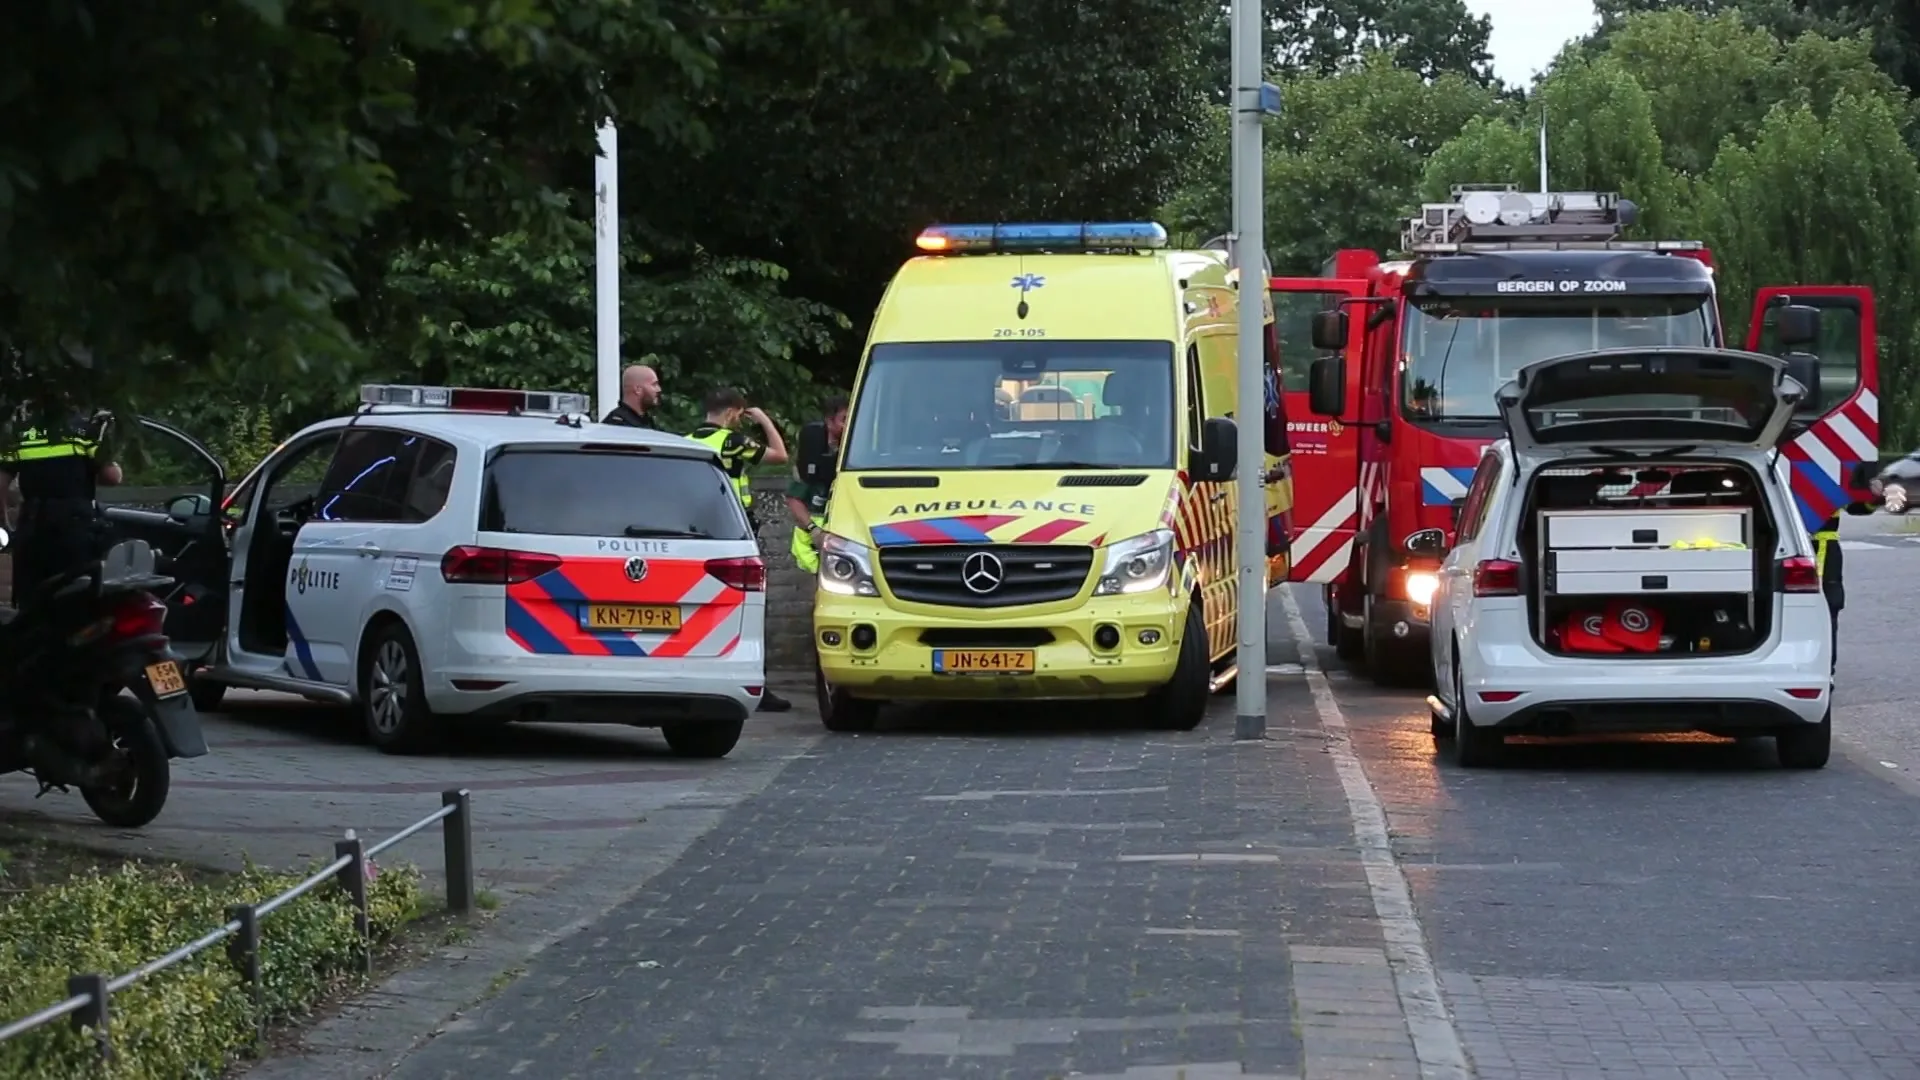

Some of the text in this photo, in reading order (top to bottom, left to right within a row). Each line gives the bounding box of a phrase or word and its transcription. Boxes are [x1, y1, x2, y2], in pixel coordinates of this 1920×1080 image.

[1497, 280, 1626, 292] BERGEN OP ZOOM
[993, 328, 1046, 338] 20-105
[1286, 421, 1328, 433] DWEER
[889, 499, 1095, 517] AMBULANCE
[597, 539, 670, 554] POLITIE
[596, 608, 673, 626] KN-719-R
[951, 652, 1026, 668] JN-641-Z
